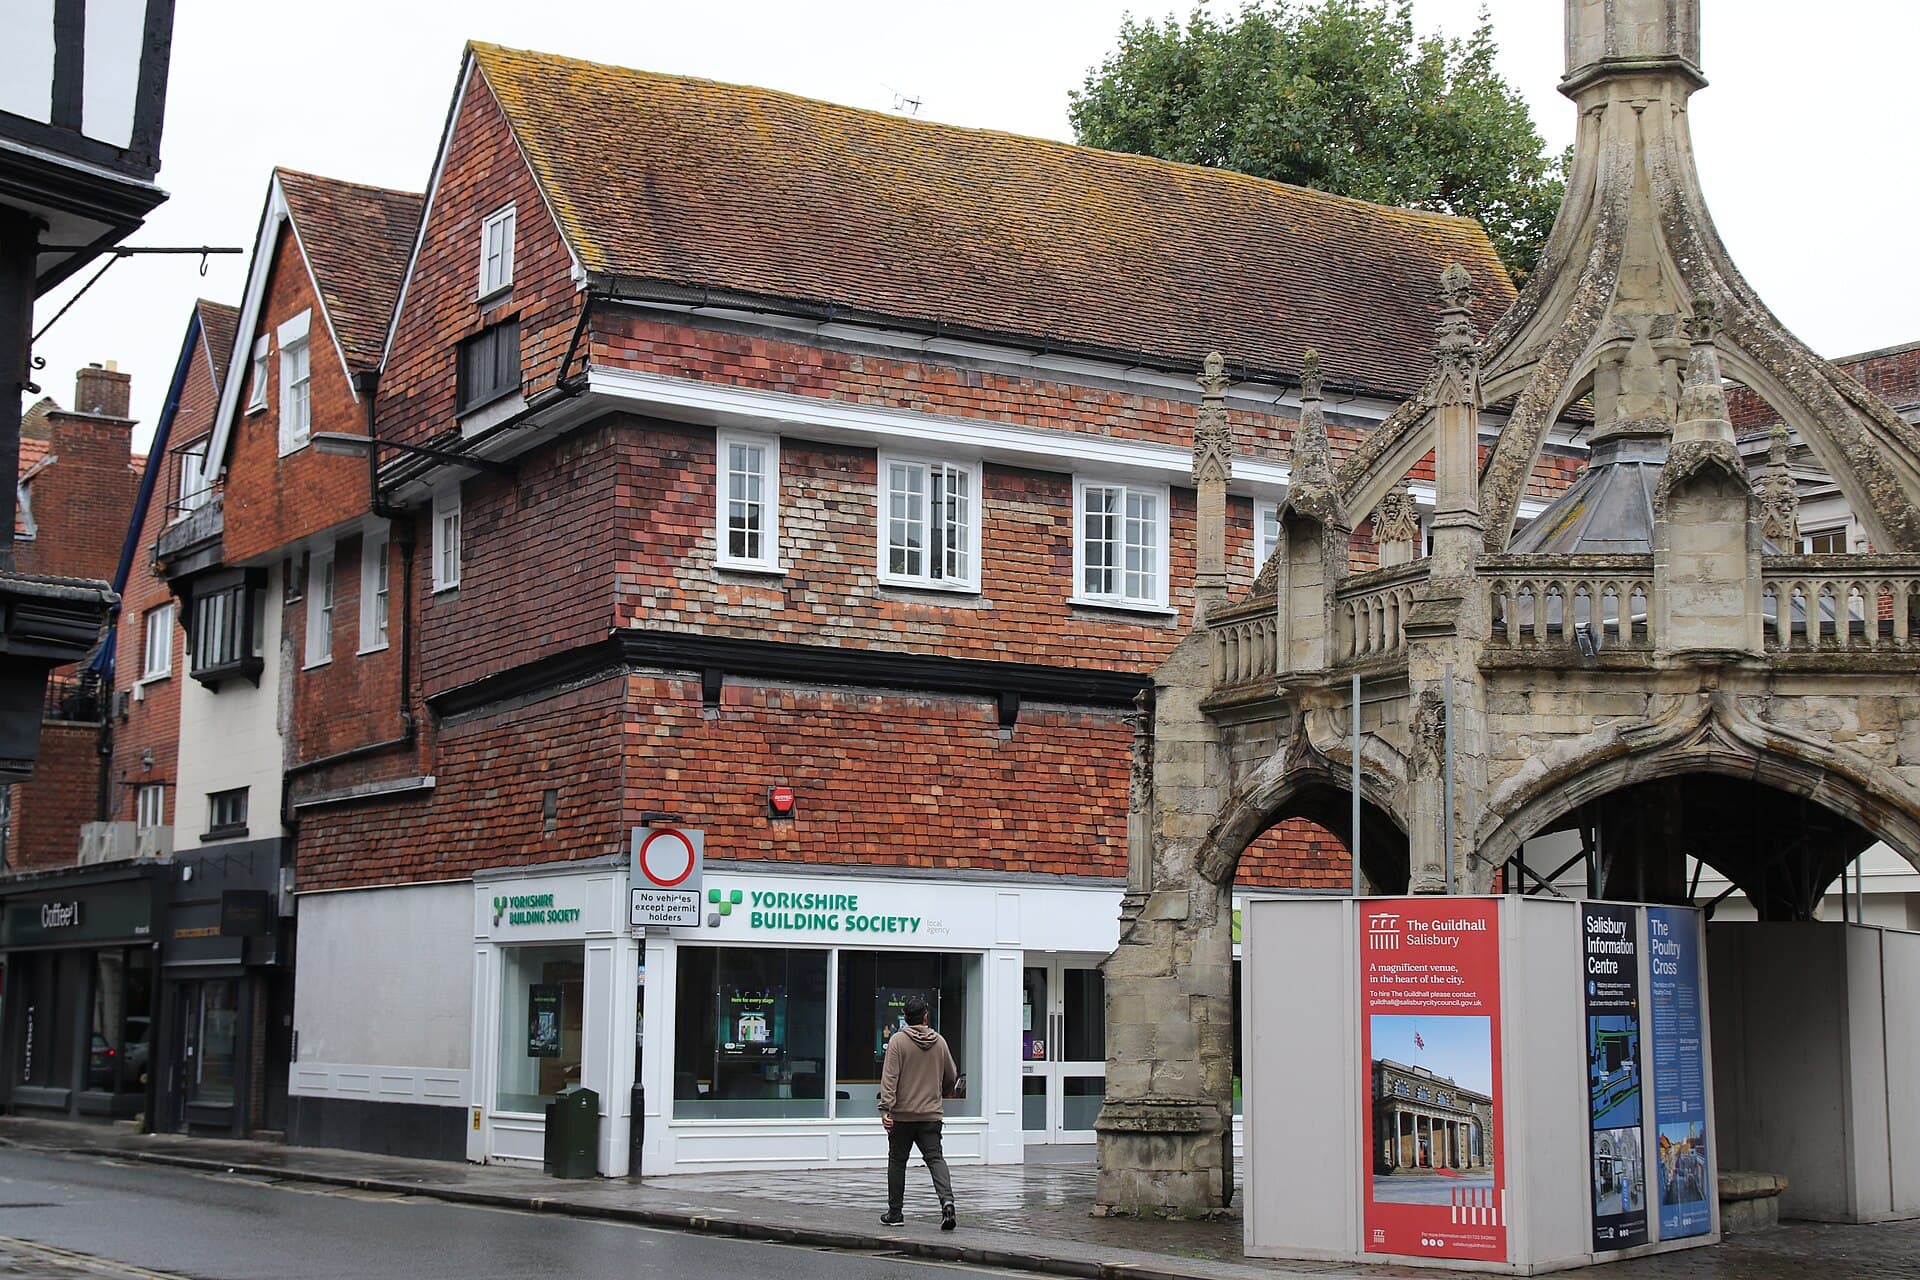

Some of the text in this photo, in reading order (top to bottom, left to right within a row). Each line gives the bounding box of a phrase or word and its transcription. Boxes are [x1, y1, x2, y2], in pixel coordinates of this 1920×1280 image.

[509, 894, 553, 908] YORKSHIRE
[641, 893, 653, 901] No
[750, 891, 858, 911] YORKSHIRE
[635, 904, 696, 912] except permit
[509, 909, 580, 925] BUILDING SOCIETY
[649, 913, 682, 921] holders
[750, 912, 921, 933] BUILDING SOCIETY
[926, 926, 950, 936] agency
[1406, 918, 1486, 931] The Guildhall
[1586, 915, 1627, 937] Salisbury
[1651, 919, 1669, 936] The
[1406, 934, 1460, 948] Salisbury
[1587, 936, 1634, 955] Information
[1652, 939, 1681, 959] Poultry
[1369, 963, 1458, 973] A magnificent venue,
[1588, 957, 1618, 974] Centre
[1652, 958, 1677, 975] Cross
[1369, 975, 1465, 985] in the heart of the city.
[1430, 991, 1451, 999] please
